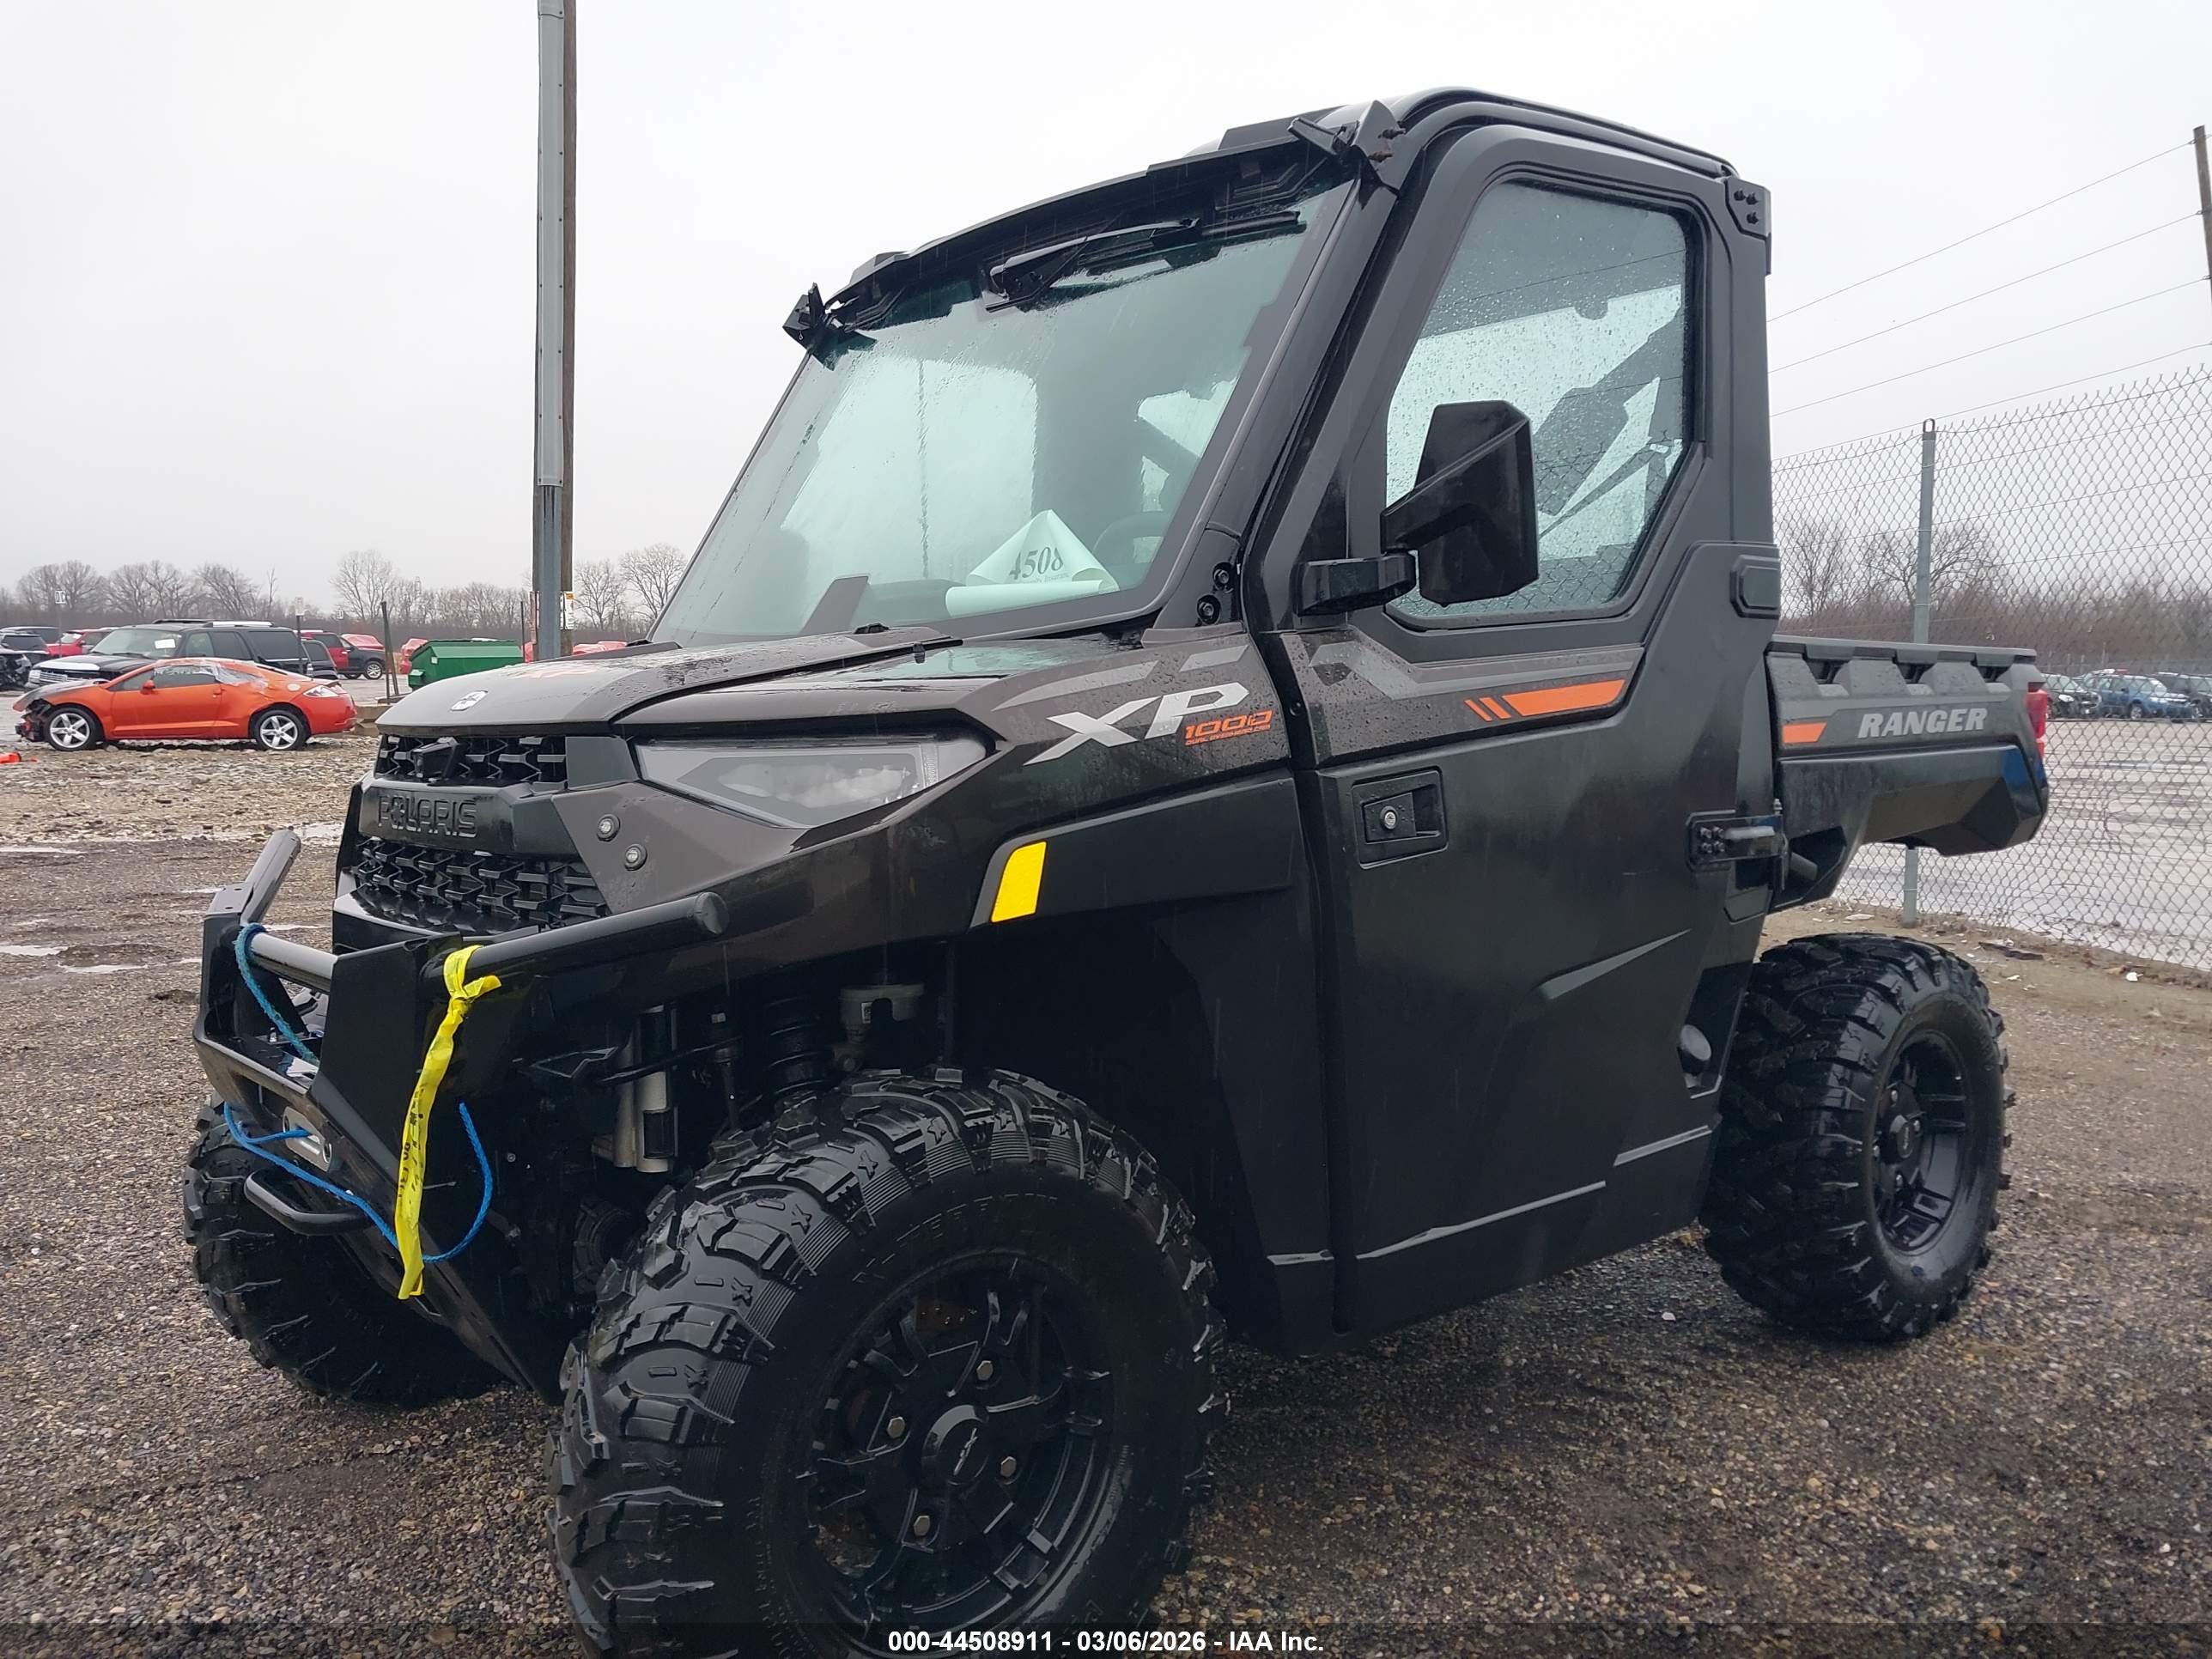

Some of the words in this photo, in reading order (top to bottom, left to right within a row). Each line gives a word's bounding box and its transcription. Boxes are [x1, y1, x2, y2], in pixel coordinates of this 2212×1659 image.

[1023, 682, 1250, 766] XP
[1185, 710, 1273, 739] 1000
[1857, 708, 1989, 738] RANGER
[378, 794, 477, 838] POLARIS
